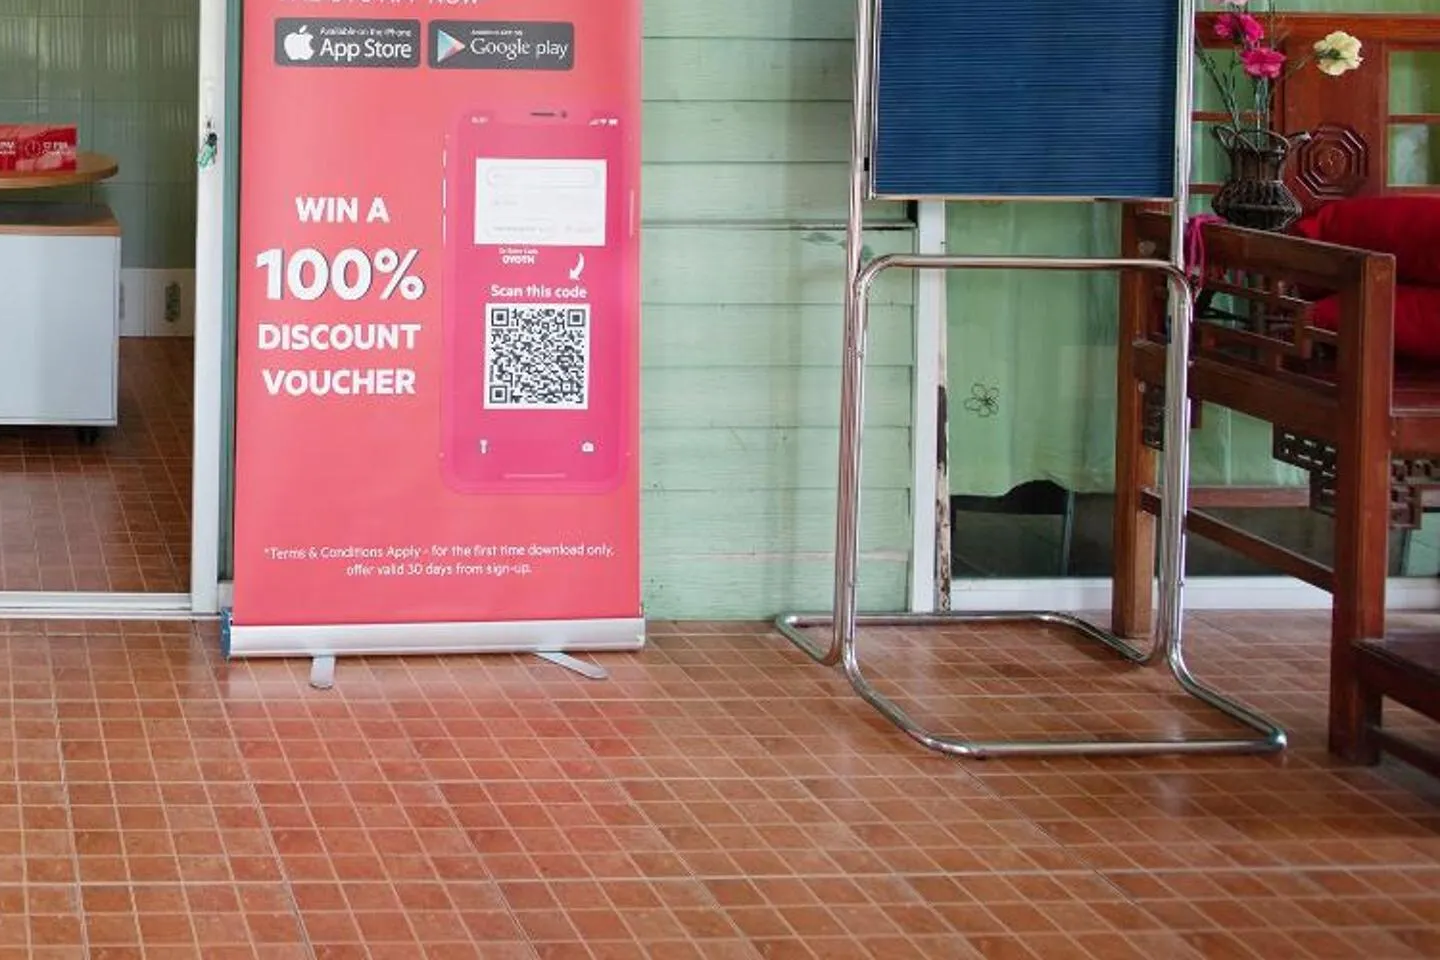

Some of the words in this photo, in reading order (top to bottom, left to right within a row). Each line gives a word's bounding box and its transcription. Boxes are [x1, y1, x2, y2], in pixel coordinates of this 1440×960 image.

[319, 40, 359, 61] App
[364, 40, 412, 59] Store
[470, 38, 530, 61] Google
[536, 40, 568, 62] play
[295, 196, 359, 223] WIN
[366, 197, 390, 223] A
[255, 247, 427, 301] 100%
[490, 284, 523, 297] Scan
[526, 284, 552, 298] this
[554, 285, 587, 299] code
[258, 323, 421, 350] DISCOUNT
[262, 369, 416, 396] VOUCHER
[309, 547, 318, 559] &
[320, 545, 383, 559] Conditions
[386, 545, 421, 560] Apply
[431, 544, 448, 556] for
[451, 544, 471, 556] the
[473, 544, 497, 556] first
[499, 544, 525, 556] time
[527, 543, 584, 556] download
[346, 563, 373, 576] offer
[377, 563, 405, 576] valid
[407, 563, 423, 576] 30
[426, 562, 452, 577] days
[455, 562, 483, 575] from
